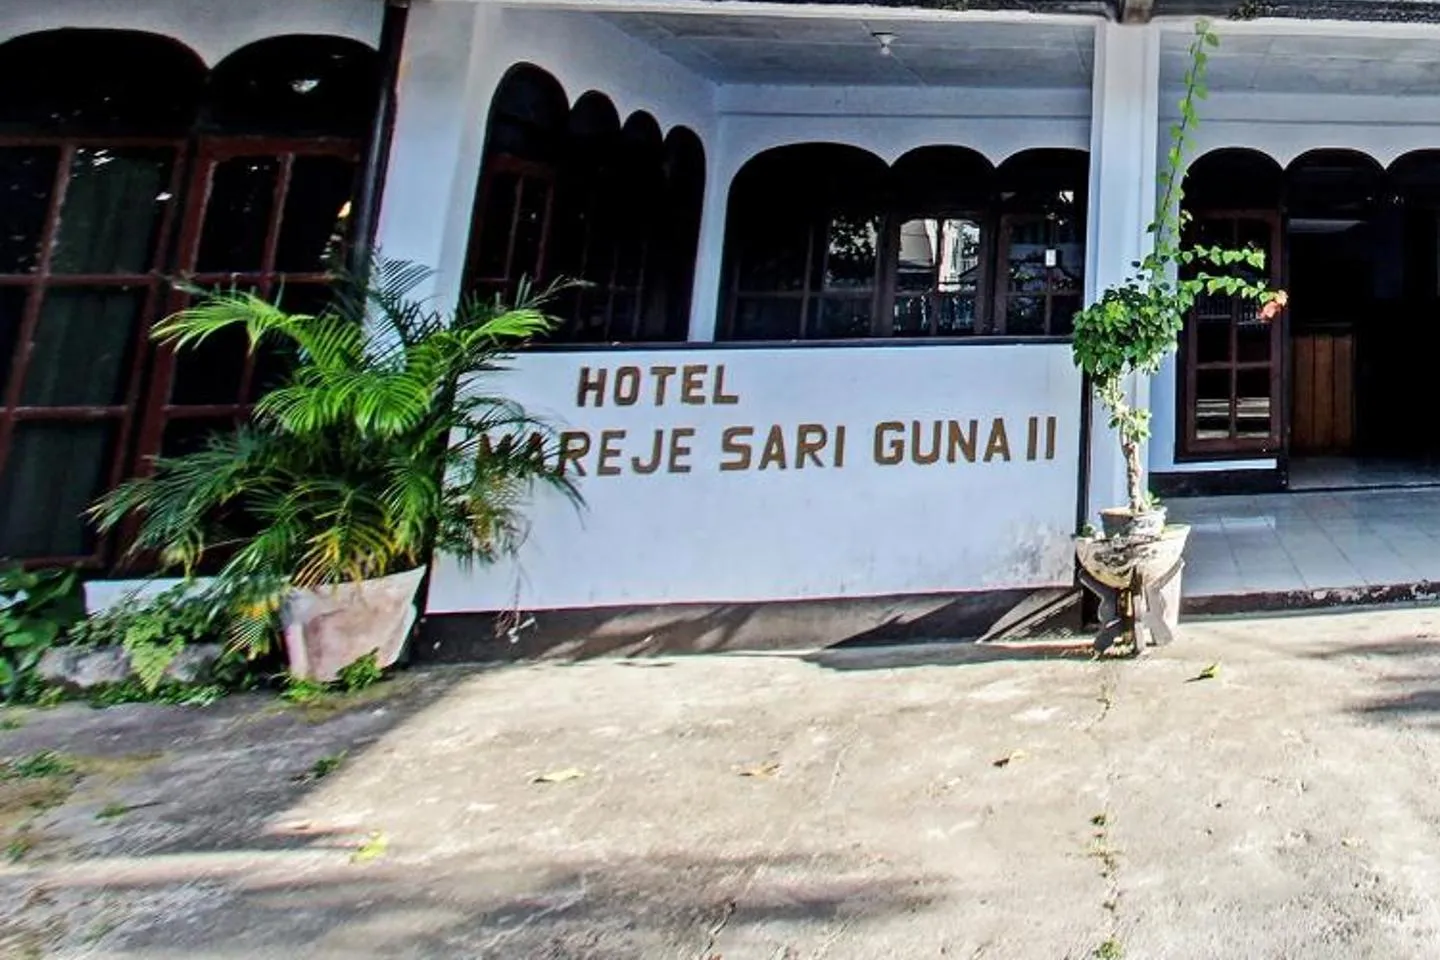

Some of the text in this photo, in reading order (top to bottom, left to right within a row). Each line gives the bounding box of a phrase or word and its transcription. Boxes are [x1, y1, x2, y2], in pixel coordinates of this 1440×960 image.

[576, 364, 739, 407] HOTEL
[719, 423, 846, 472] SARI
[873, 417, 1011, 466] GUNA
[1027, 416, 1057, 461] II
